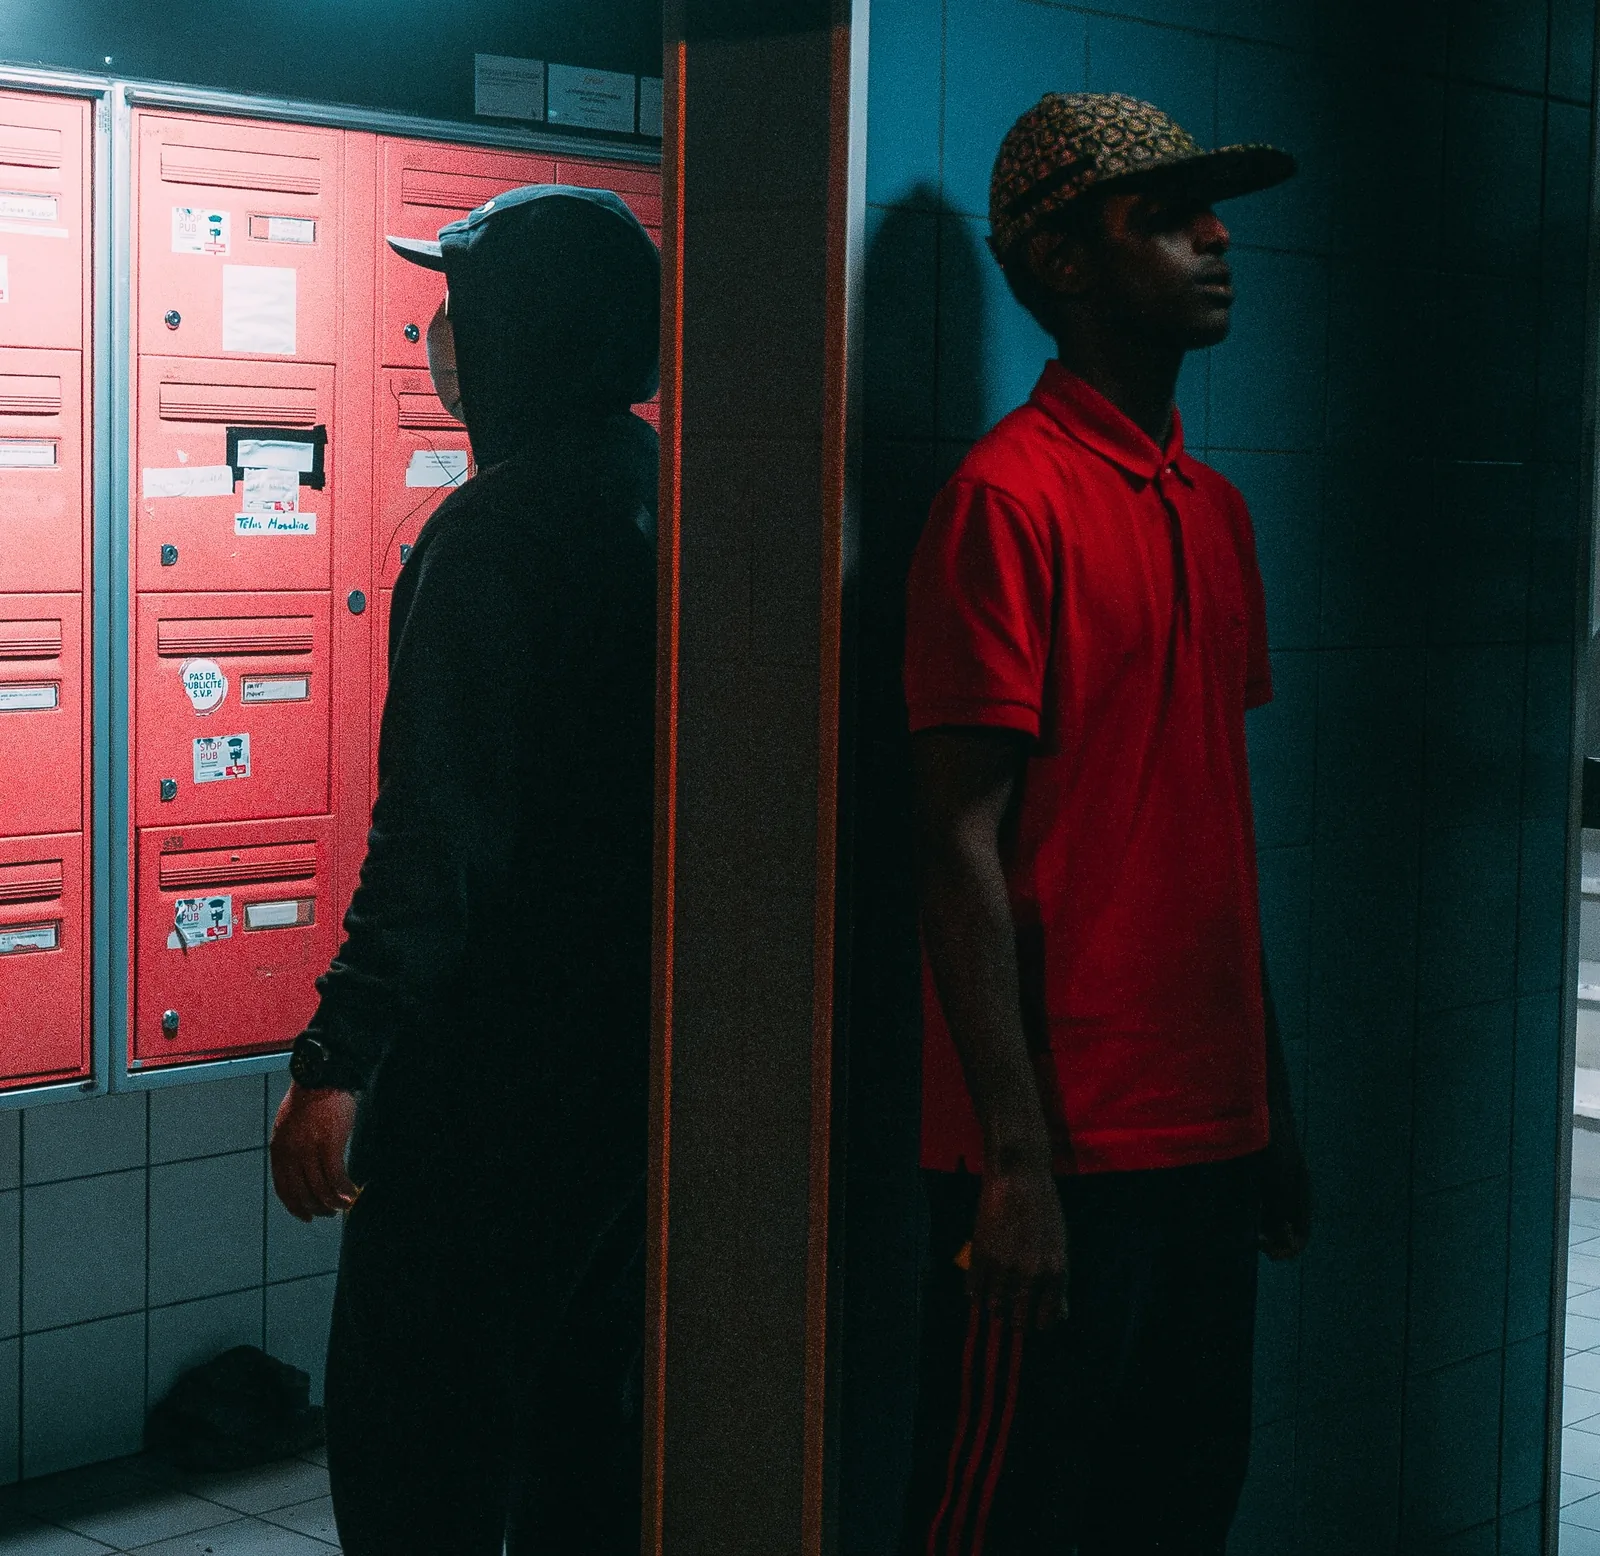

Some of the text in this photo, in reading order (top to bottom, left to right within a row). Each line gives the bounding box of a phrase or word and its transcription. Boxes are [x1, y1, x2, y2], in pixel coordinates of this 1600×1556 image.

[178, 212, 202, 223] STOP
[179, 222, 197, 233] PUB
[189, 672, 216, 681] PAS DE
[183, 678, 222, 690] PUBLICITÉ
[193, 689, 213, 698] S.V.P.
[199, 741, 223, 752] STOP
[200, 751, 218, 761] PUB
[183, 902, 204, 913] TOP
[182, 912, 200, 922] PUB
